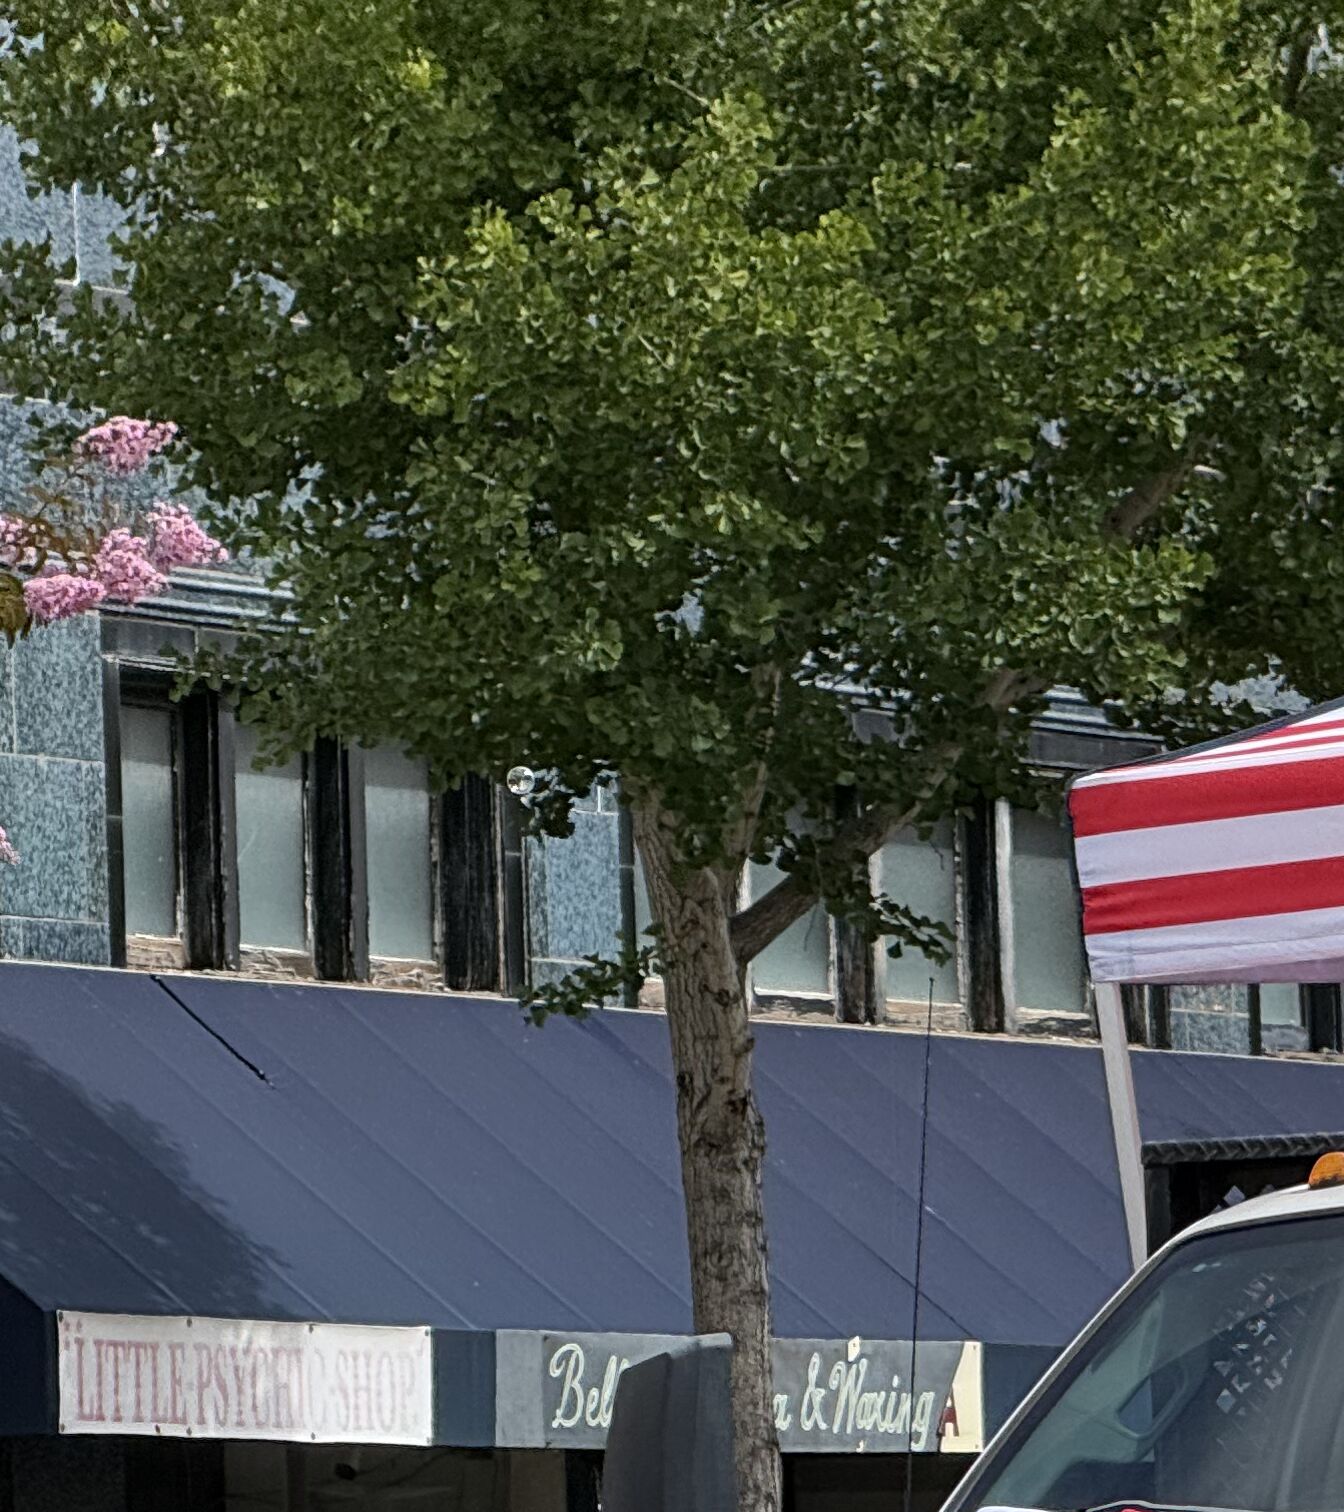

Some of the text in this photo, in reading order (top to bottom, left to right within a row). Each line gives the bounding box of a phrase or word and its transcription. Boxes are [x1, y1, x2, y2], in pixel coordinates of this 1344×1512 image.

[73, 1336, 416, 1434] LITTLE PSYCHIC SHOP
[800, 1351, 828, 1433] &
[828, 1356, 936, 1452] Waxing
